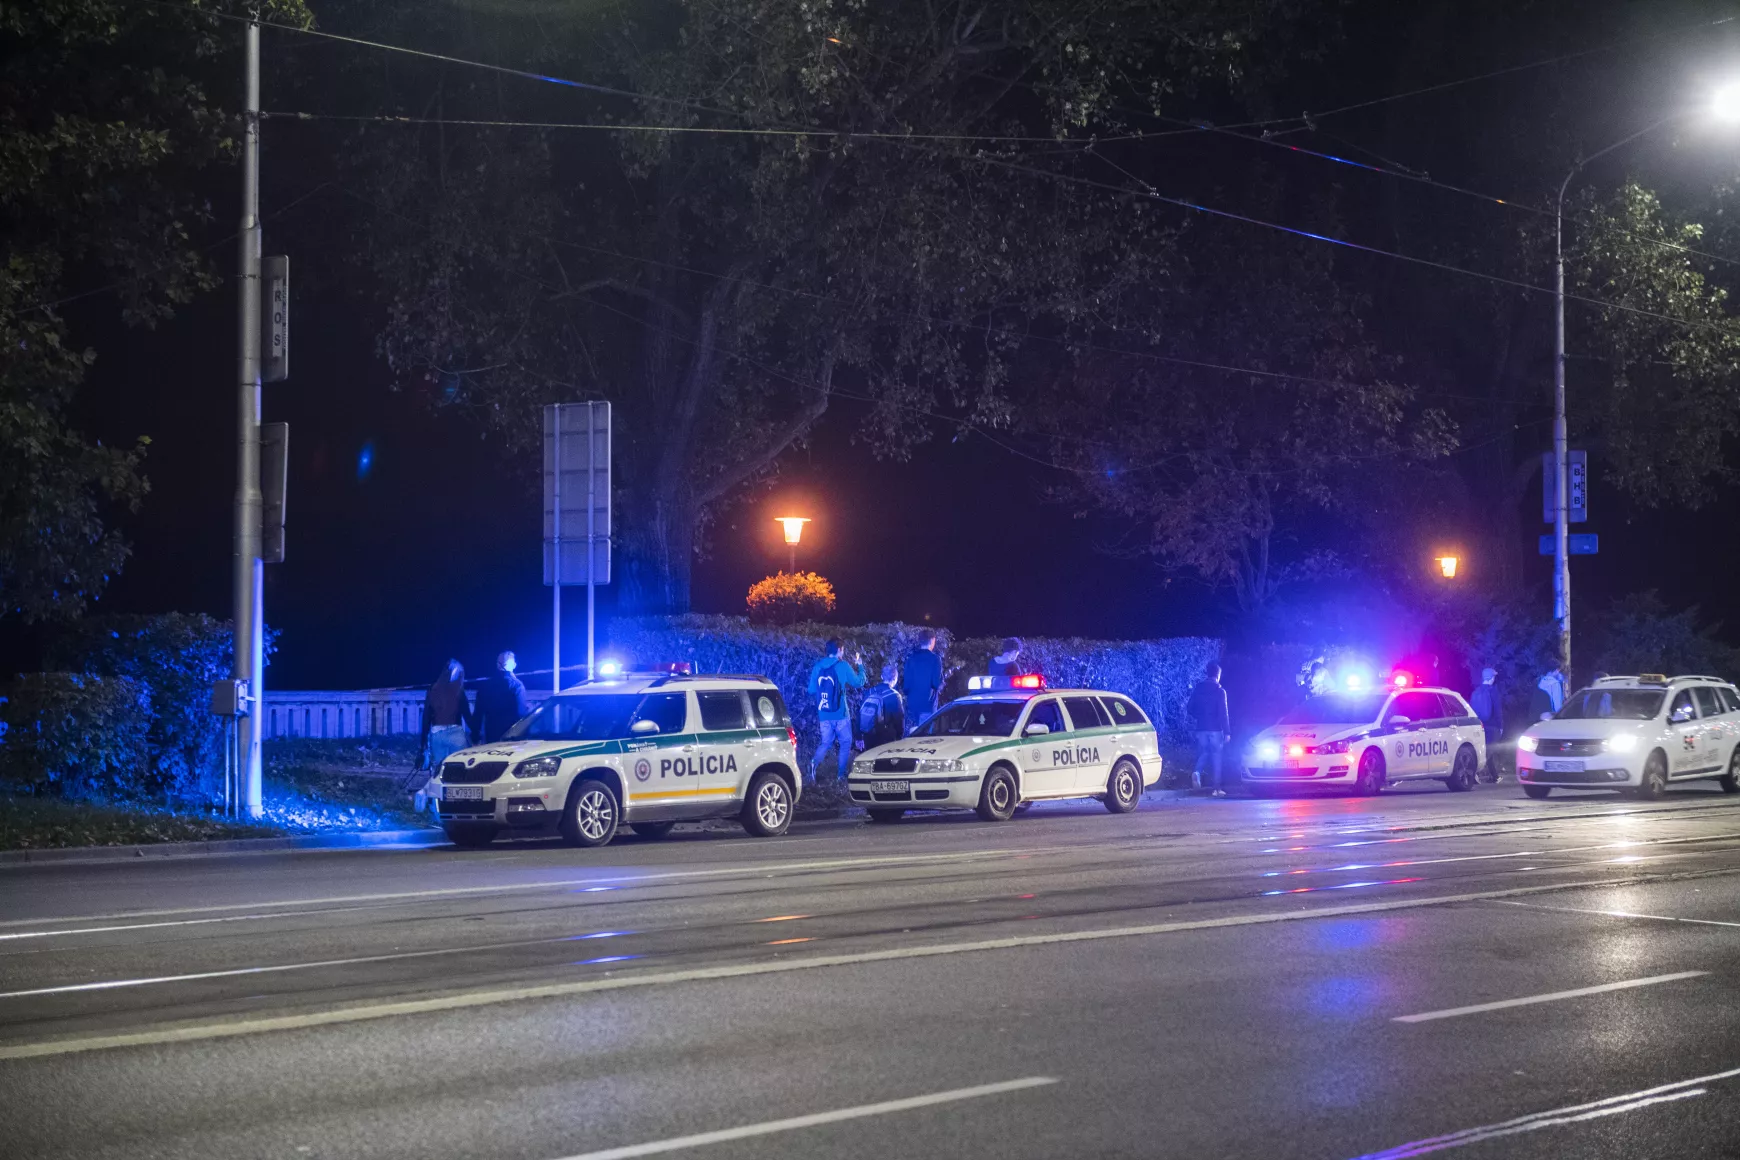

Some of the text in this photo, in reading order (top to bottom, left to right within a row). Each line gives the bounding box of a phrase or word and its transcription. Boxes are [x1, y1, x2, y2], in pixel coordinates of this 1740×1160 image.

[818, 692, 829, 711] EA7
[1053, 745, 1100, 766] POLÍCIA
[1409, 738, 1449, 757] POLÍCIA
[660, 752, 737, 778] POLÍCIA
